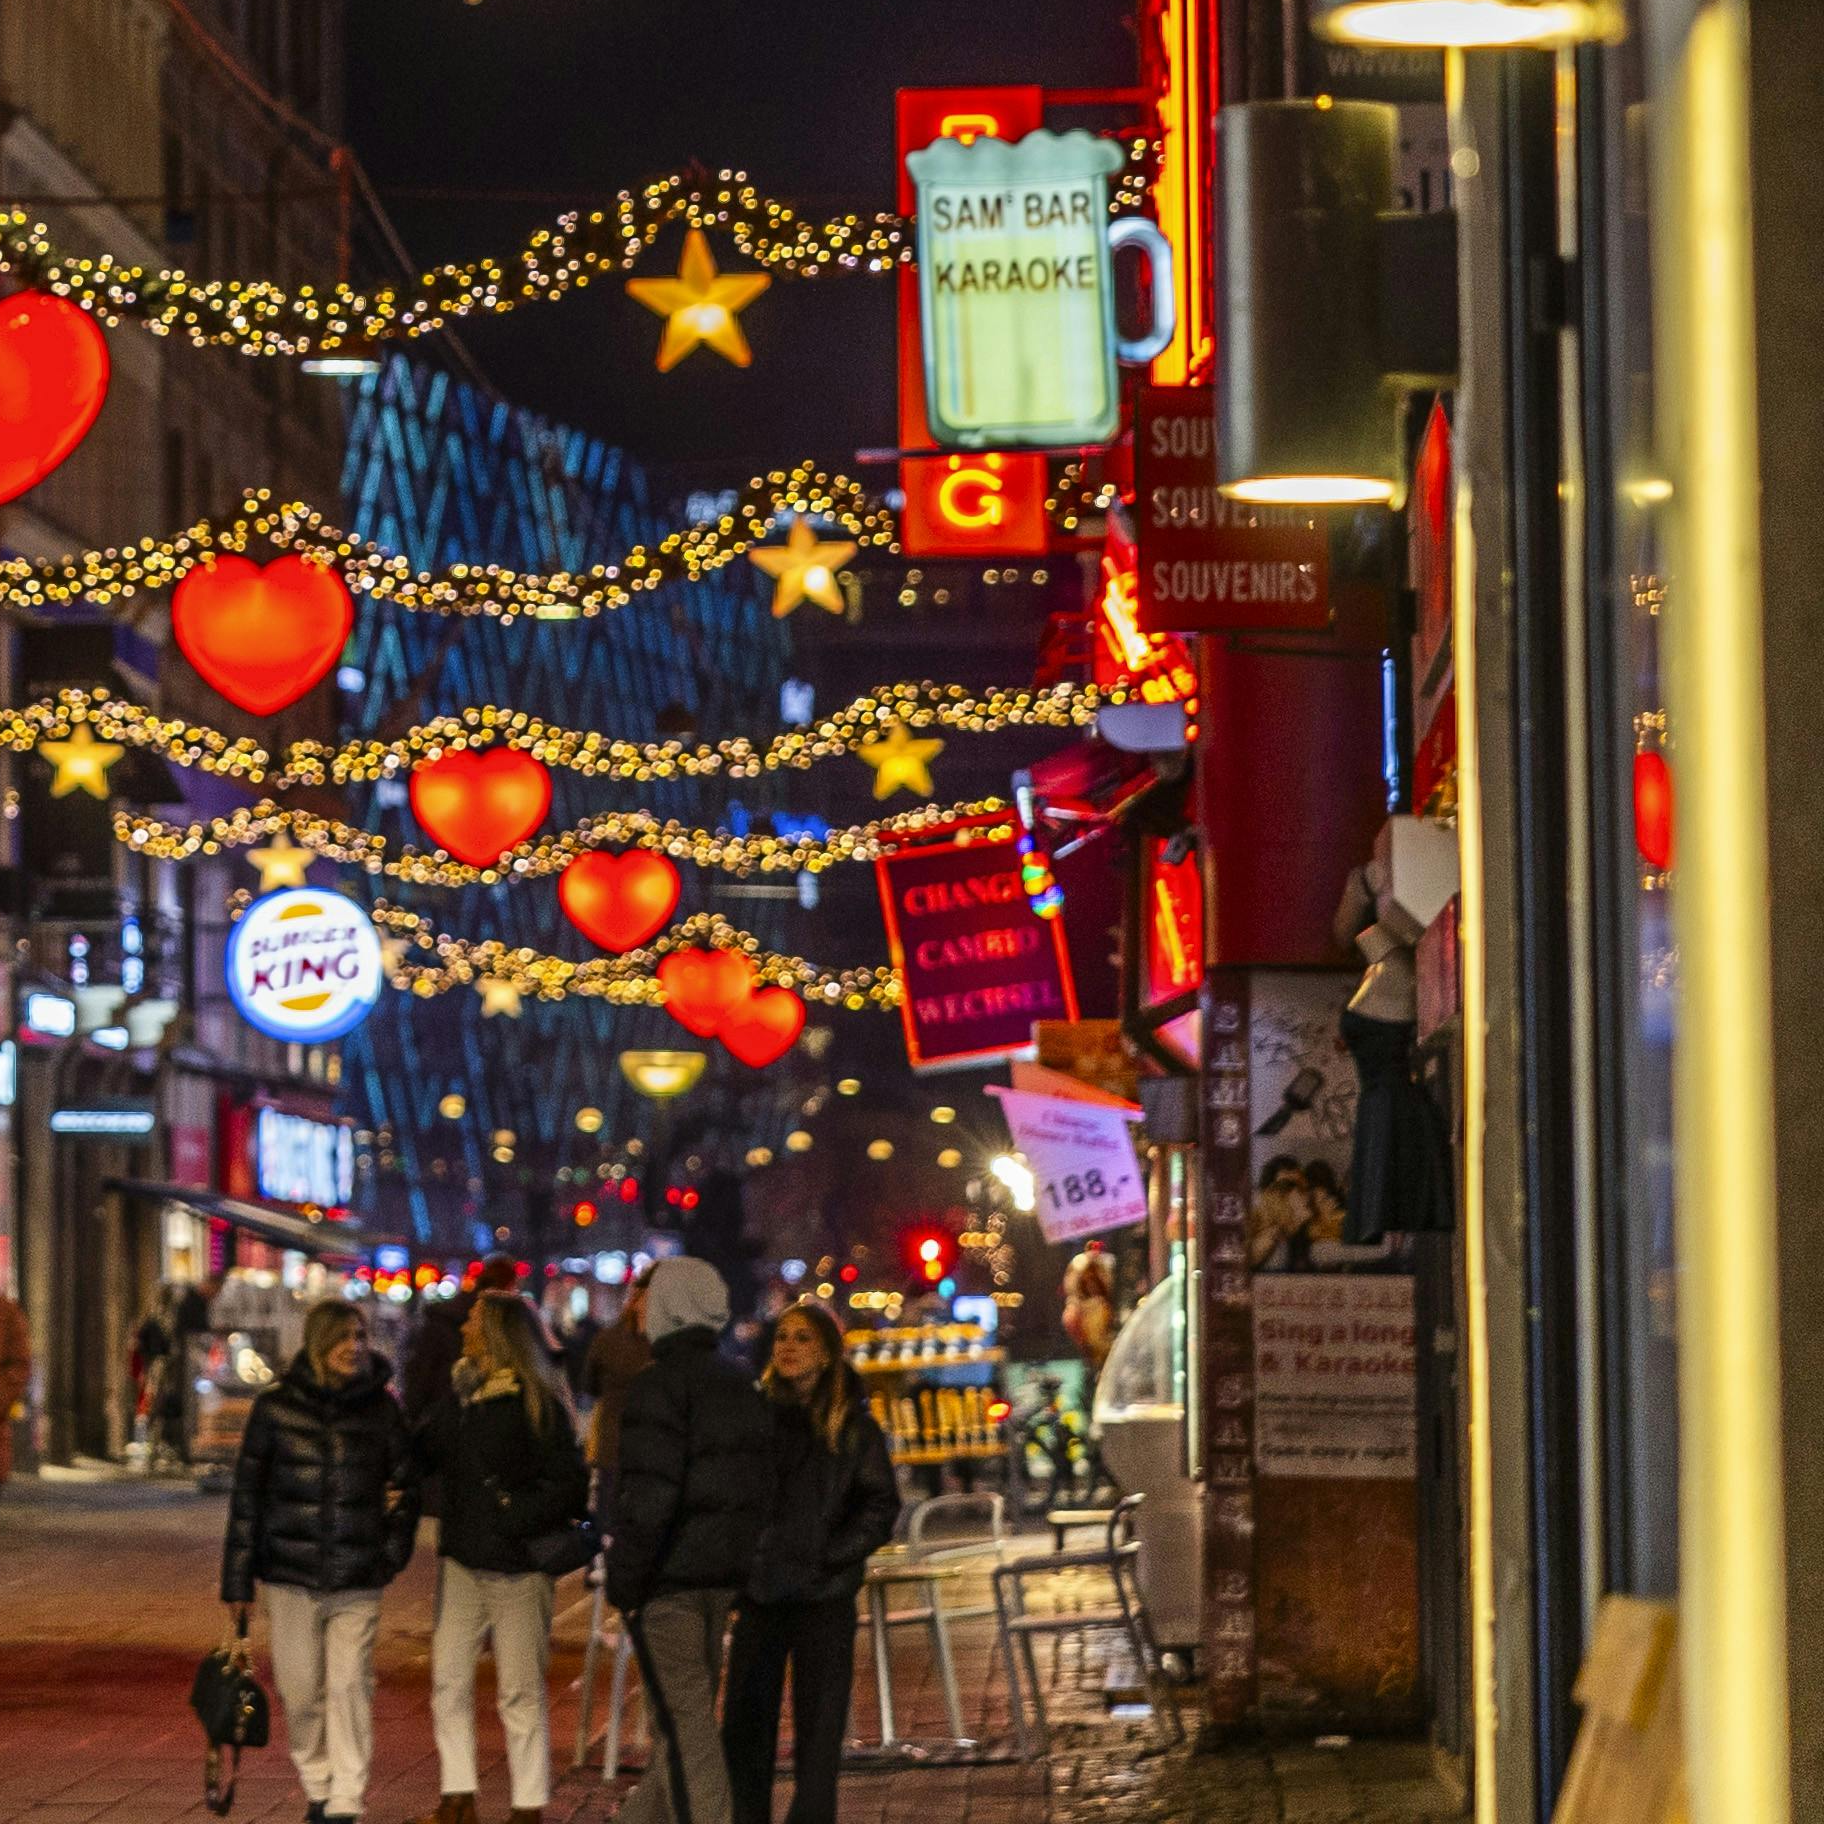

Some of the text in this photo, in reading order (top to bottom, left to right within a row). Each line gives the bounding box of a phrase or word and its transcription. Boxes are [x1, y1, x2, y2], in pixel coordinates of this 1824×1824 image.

[1023, 188, 1095, 231] BAR
[934, 253, 1097, 297] KARAOKE
[1153, 560, 1318, 603] SOUVENIRS
[248, 947, 361, 997] KING
[1294, 1351, 1416, 1375] Karaoke
